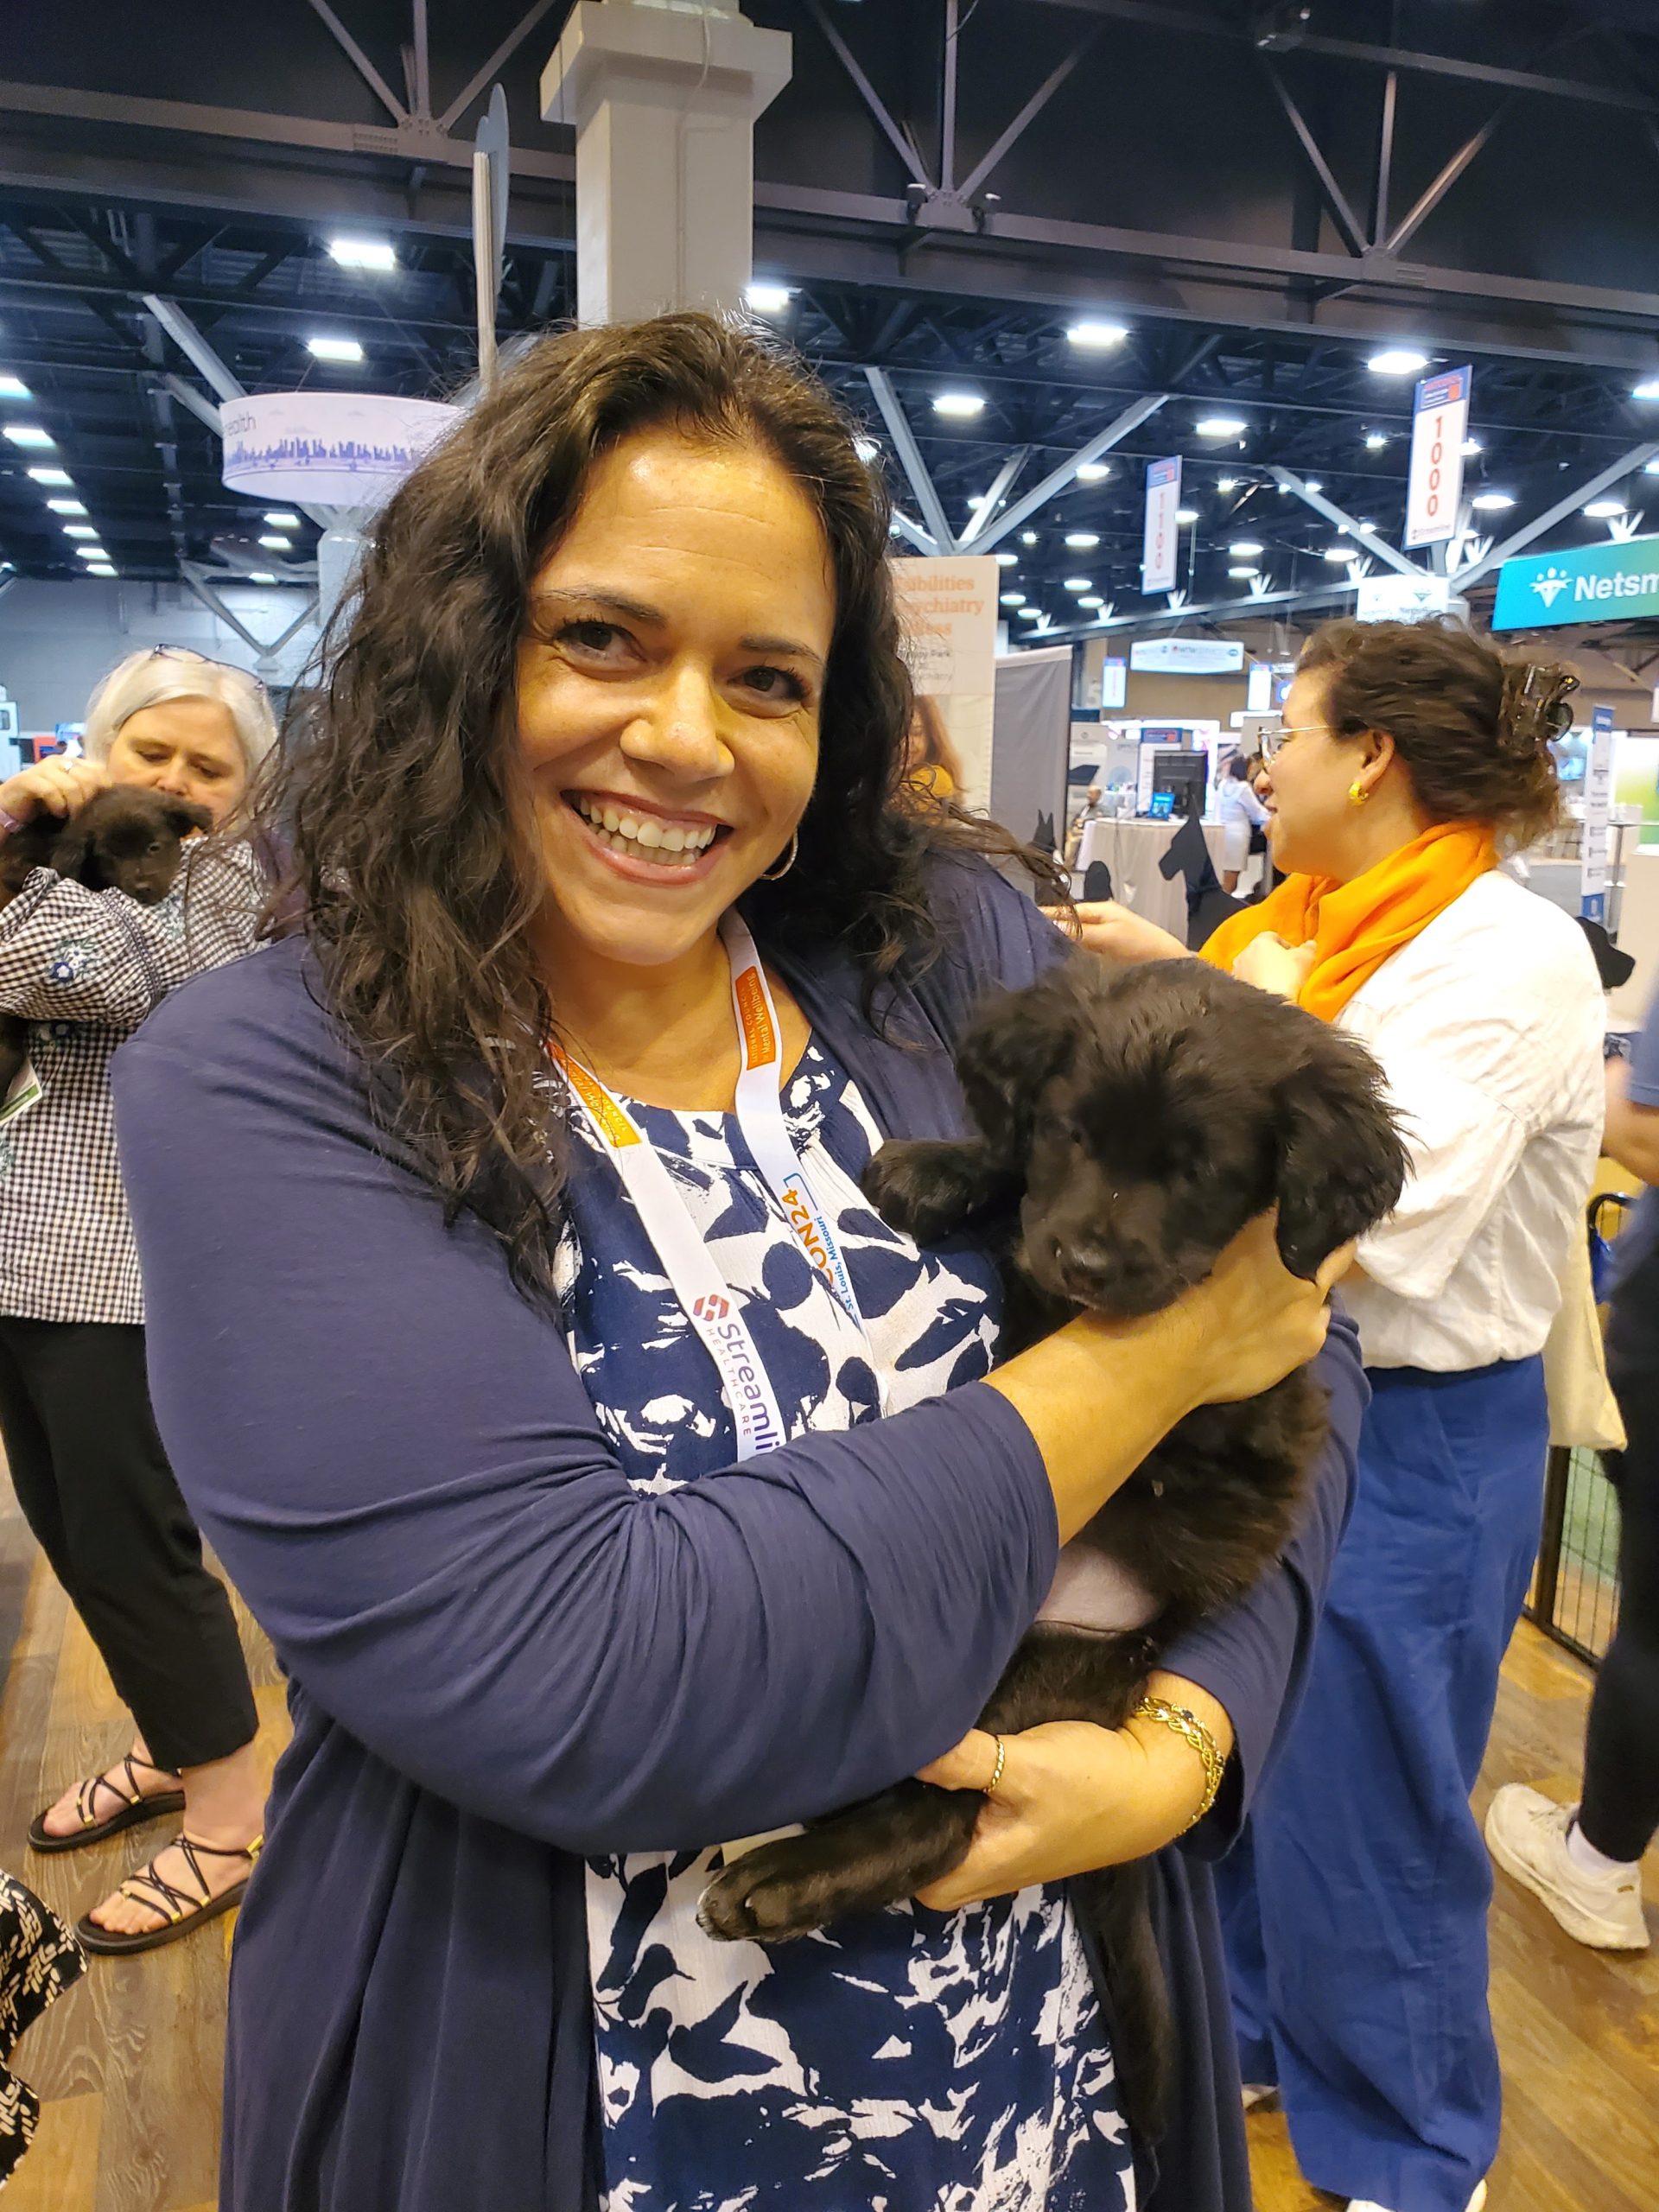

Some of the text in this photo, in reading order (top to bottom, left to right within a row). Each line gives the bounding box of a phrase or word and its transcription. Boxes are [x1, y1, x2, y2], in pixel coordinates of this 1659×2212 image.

[1427, 416, 1443, 517] 1000
[1154, 492, 1166, 569] 1100
[740, 988, 754, 1027] COUNCIL
[747, 971, 766, 1025] Wellbeing
[757, 1024, 772, 1054] Mental
[813, 1216, 855, 1311] St. Louis, Missouri
[706, 1328, 752, 1436] HEALTHCARE
